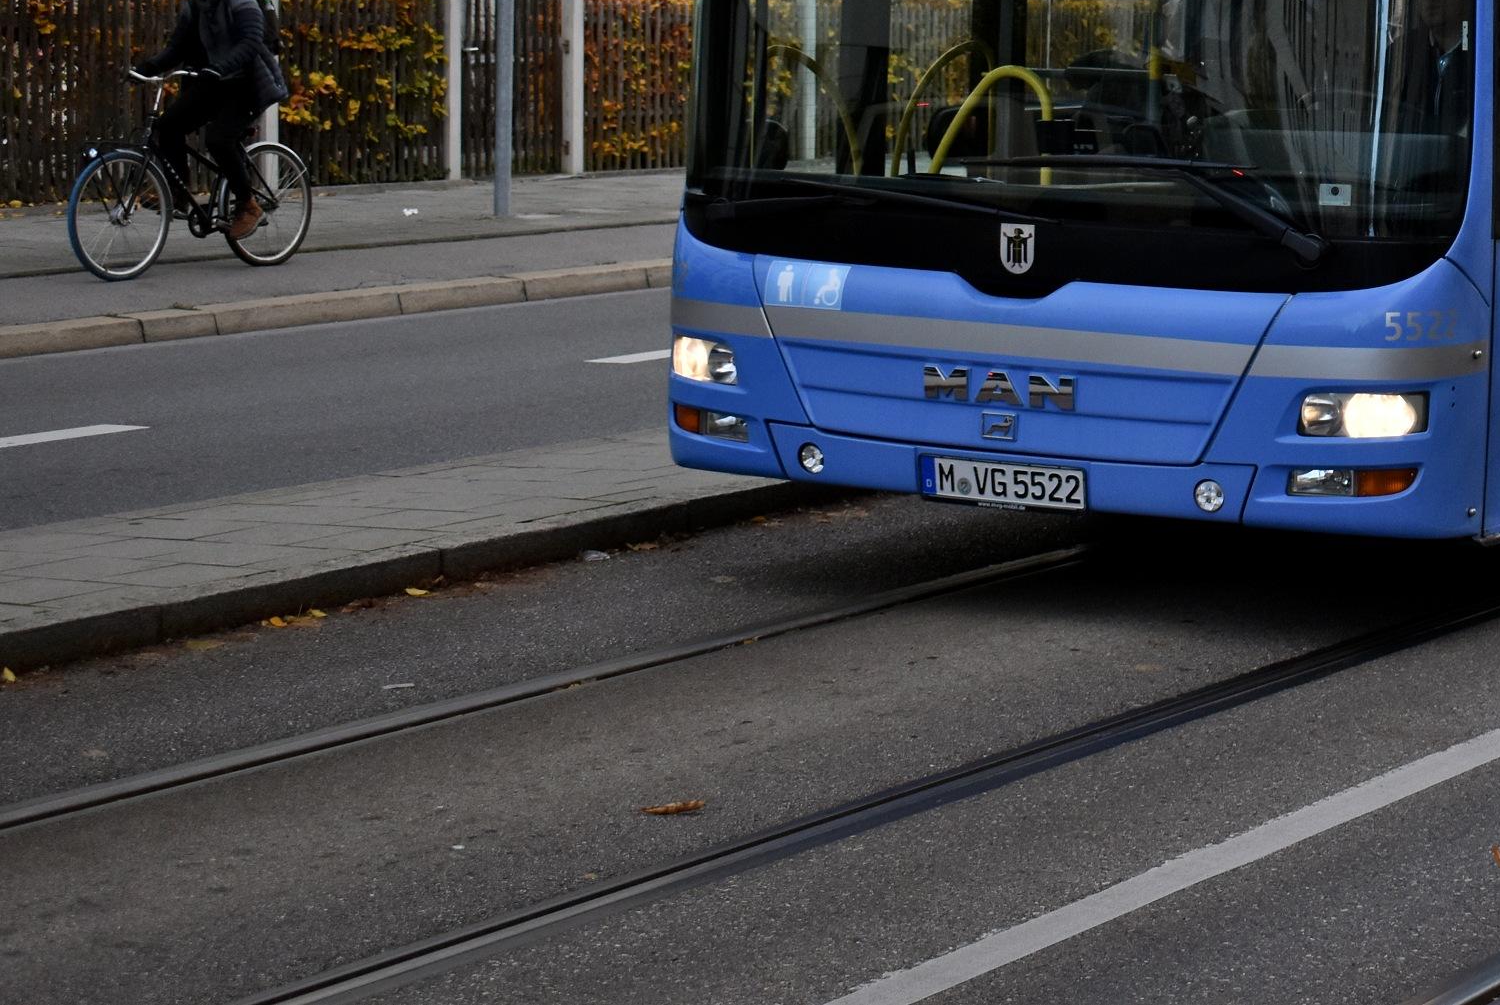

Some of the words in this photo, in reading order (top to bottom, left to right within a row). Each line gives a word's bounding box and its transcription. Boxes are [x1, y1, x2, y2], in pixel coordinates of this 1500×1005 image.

[1384, 309, 1458, 342] 5522
[923, 363, 1079, 412] MAN
[1013, 470, 1081, 505] 5522
